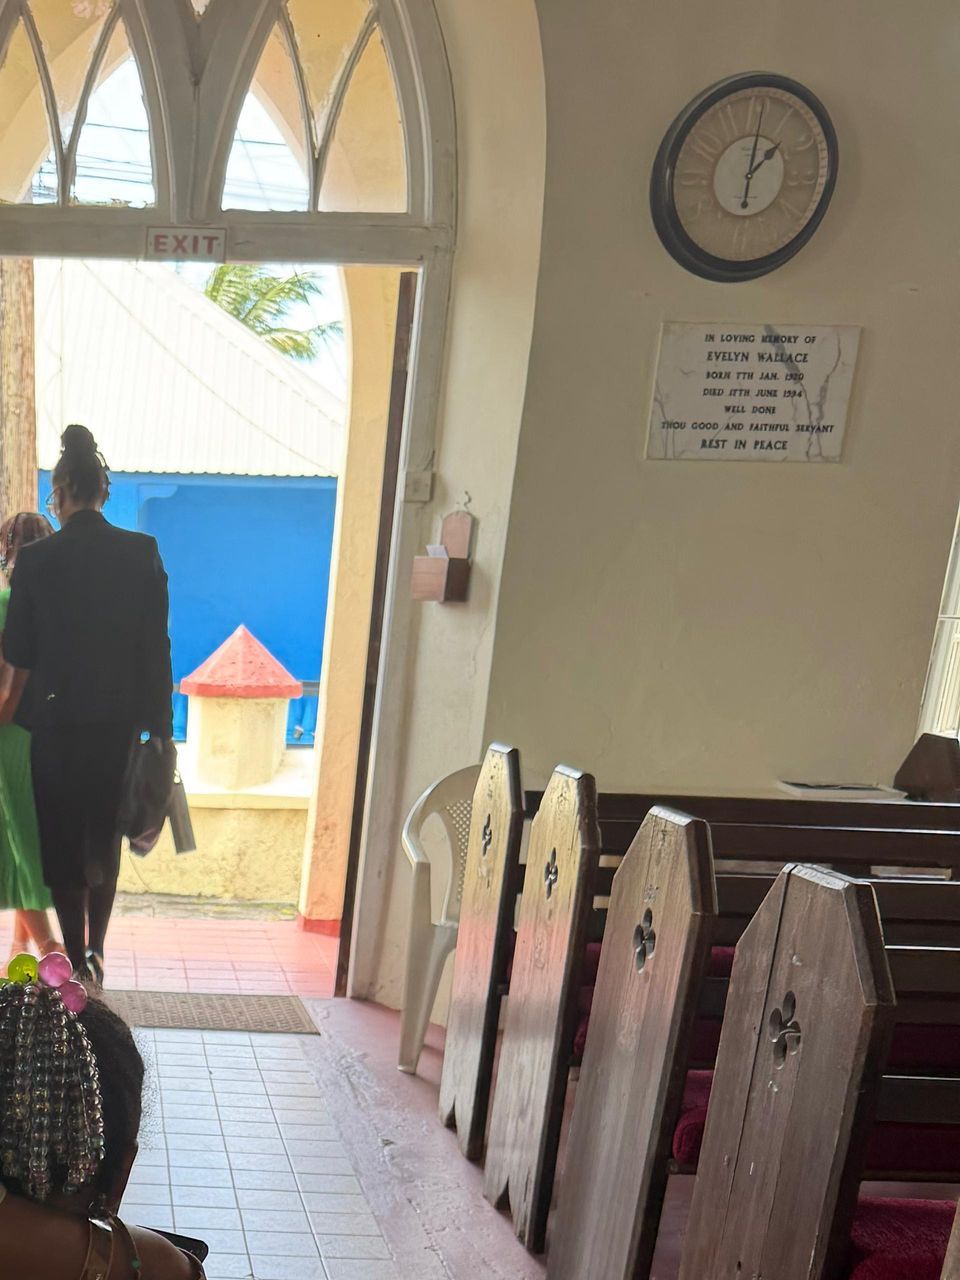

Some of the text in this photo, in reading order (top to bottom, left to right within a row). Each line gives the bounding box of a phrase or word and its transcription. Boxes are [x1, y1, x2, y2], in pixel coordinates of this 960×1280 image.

[154, 234, 219, 255] EXIT
[704, 334, 817, 344] IN LOVING MEMORY OF
[706, 351, 809, 363] EVELYN WALLACE
[705, 371, 732, 380] BORN
[703, 388, 725, 397] DIED
[755, 389, 779, 398] JUNE
[724, 405, 776, 414] WELL DONE
[661, 421, 834, 434] THOU GOOD AND FAITHFUL SERVANT
[700, 439, 789, 450] REST IN PEACE
